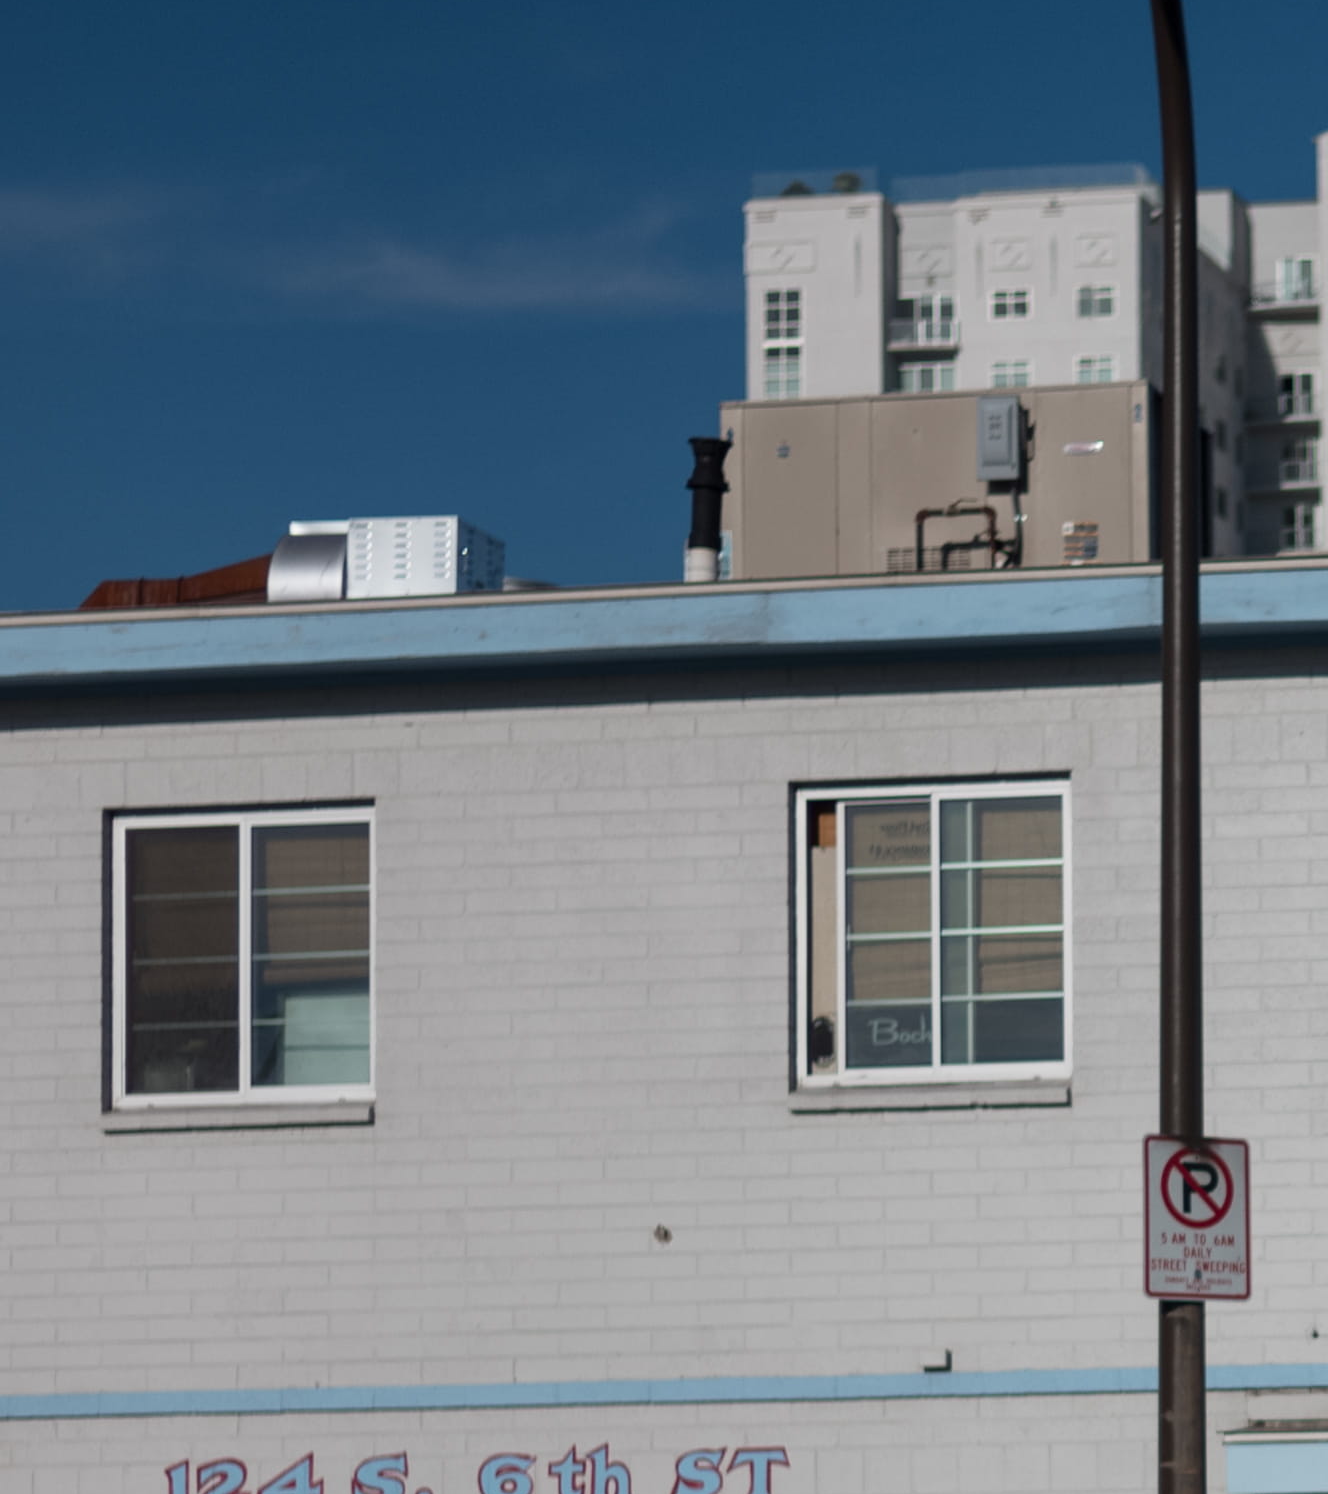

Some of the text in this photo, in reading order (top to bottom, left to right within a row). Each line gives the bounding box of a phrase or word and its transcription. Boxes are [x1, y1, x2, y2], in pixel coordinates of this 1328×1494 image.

[1194, 1234, 1207, 1246] TO
[1183, 1247, 1212, 1259] DAILY
[1151, 1258, 1246, 1274] STREET SWEEPING
